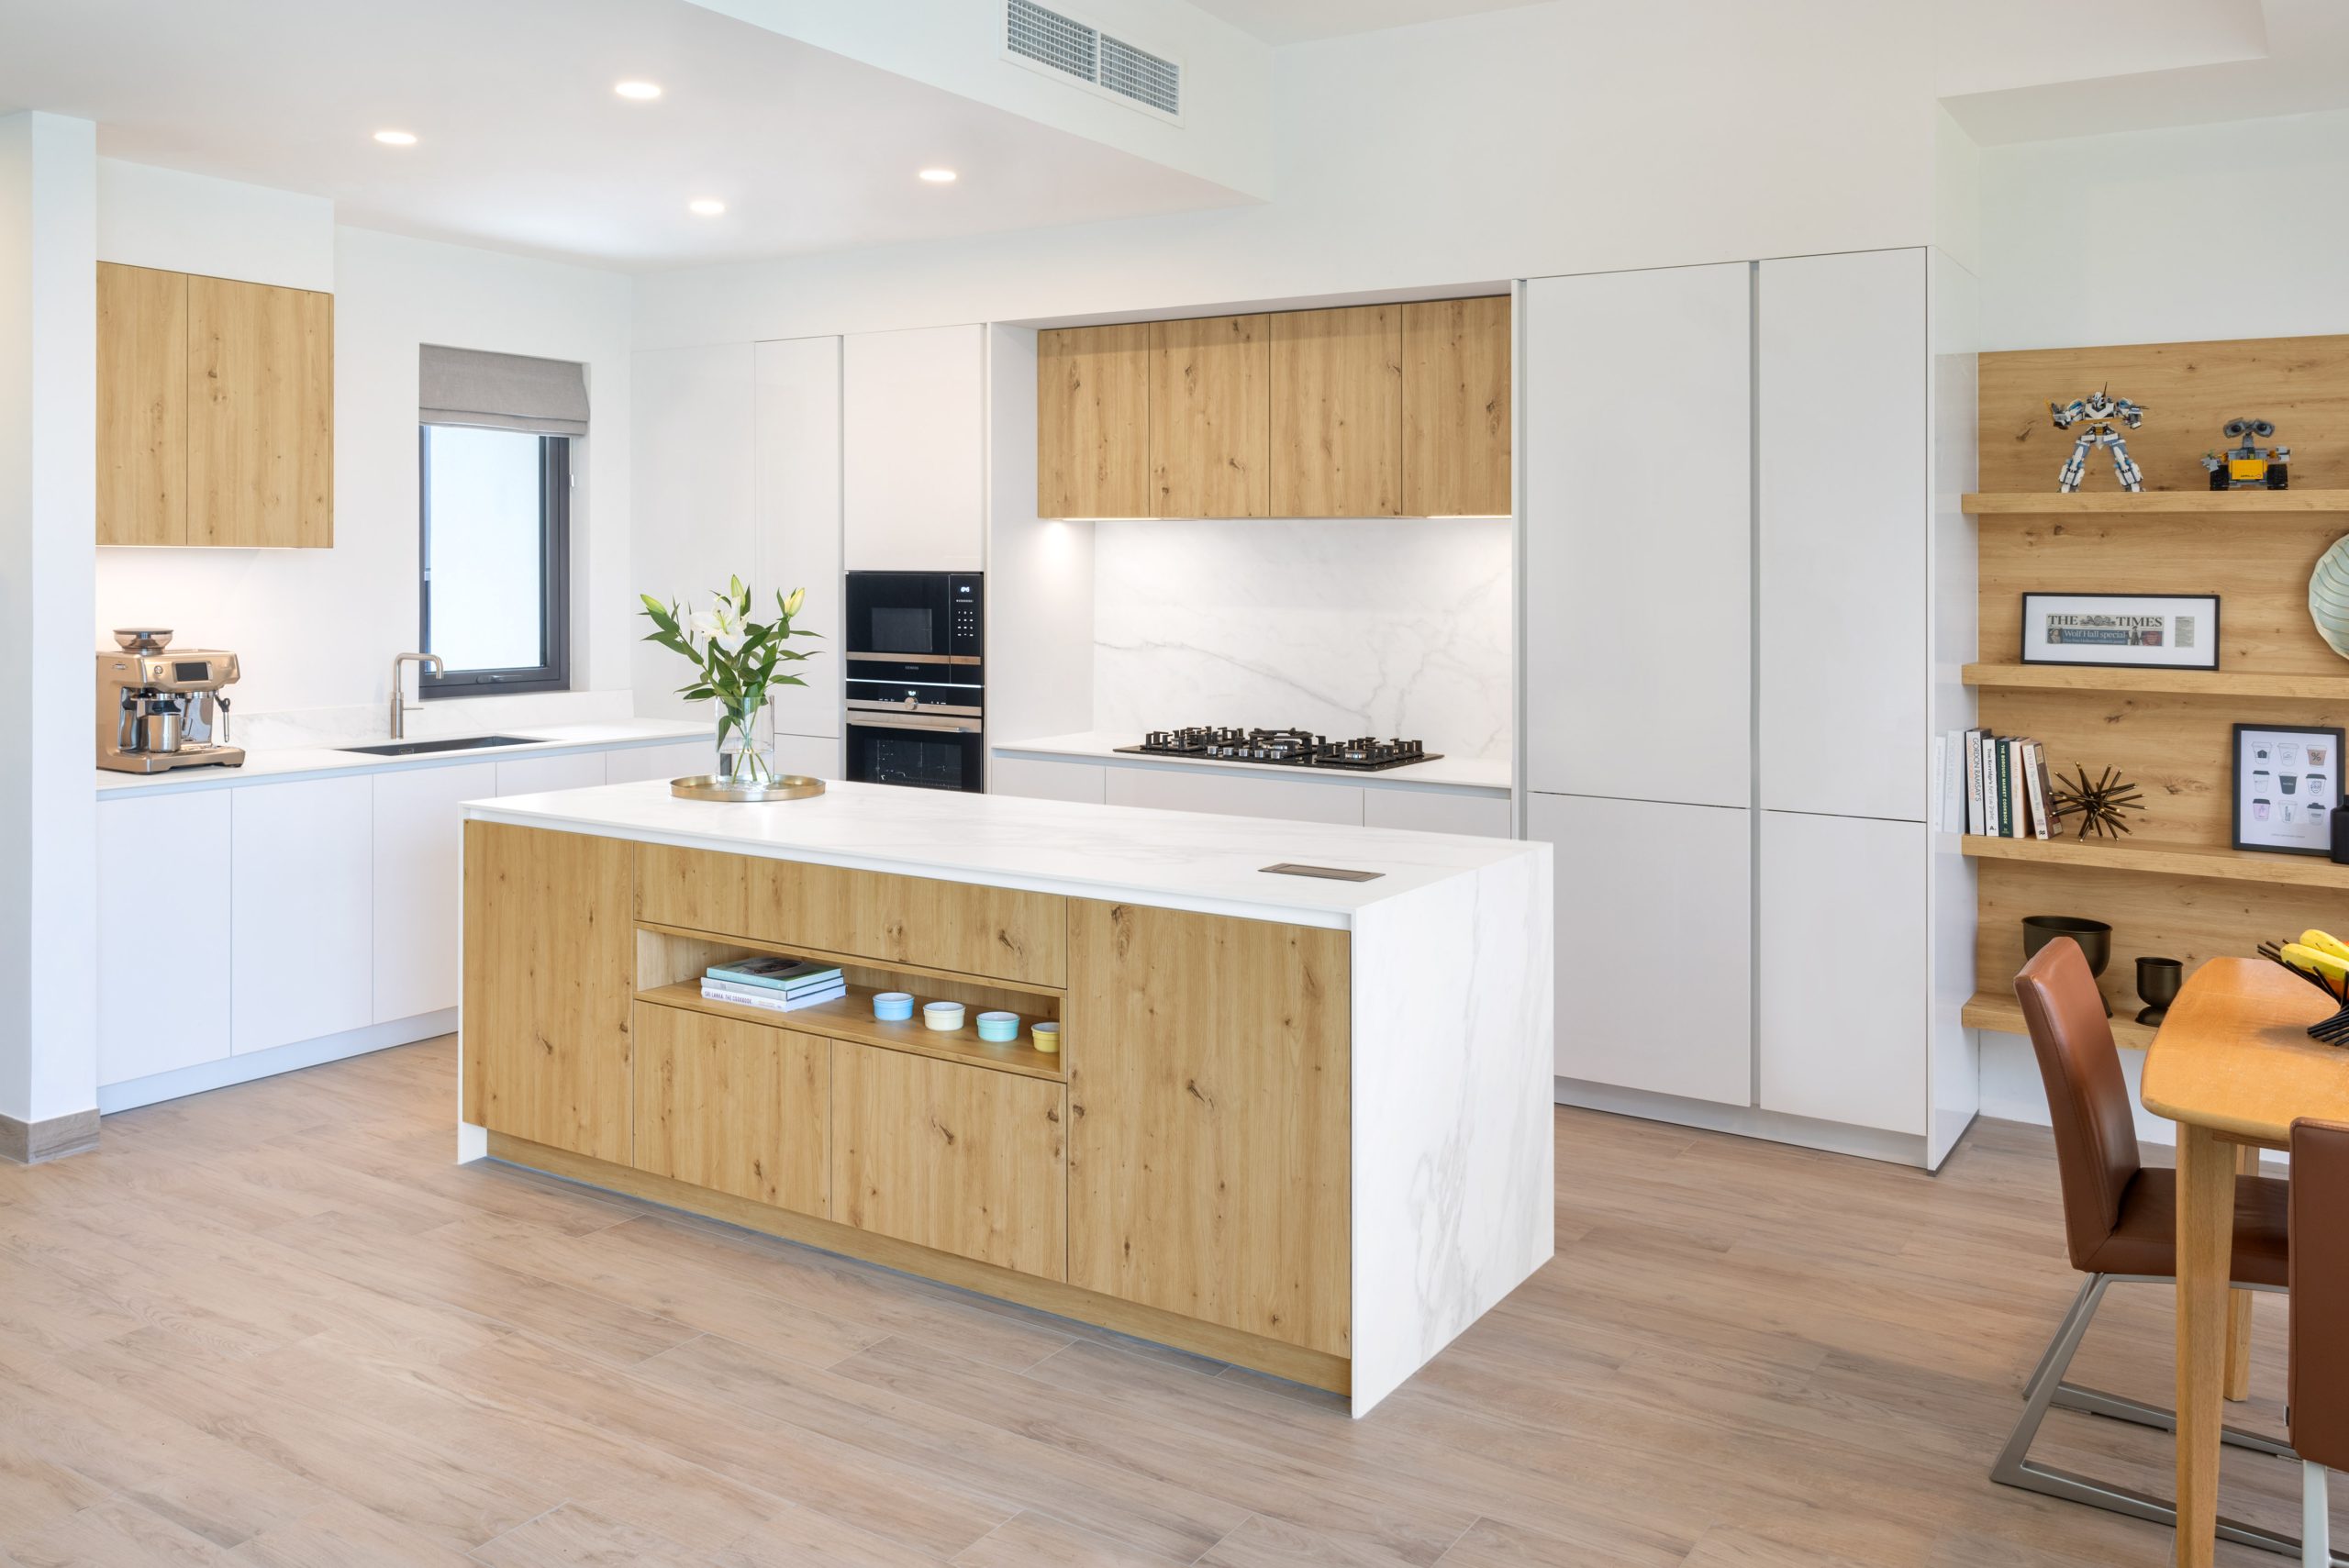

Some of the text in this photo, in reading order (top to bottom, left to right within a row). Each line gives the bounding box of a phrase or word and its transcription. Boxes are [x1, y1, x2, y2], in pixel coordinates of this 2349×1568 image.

[2048, 615, 2163, 628] THE TIMES
[2064, 629, 2126, 639] Wolf Hall special
